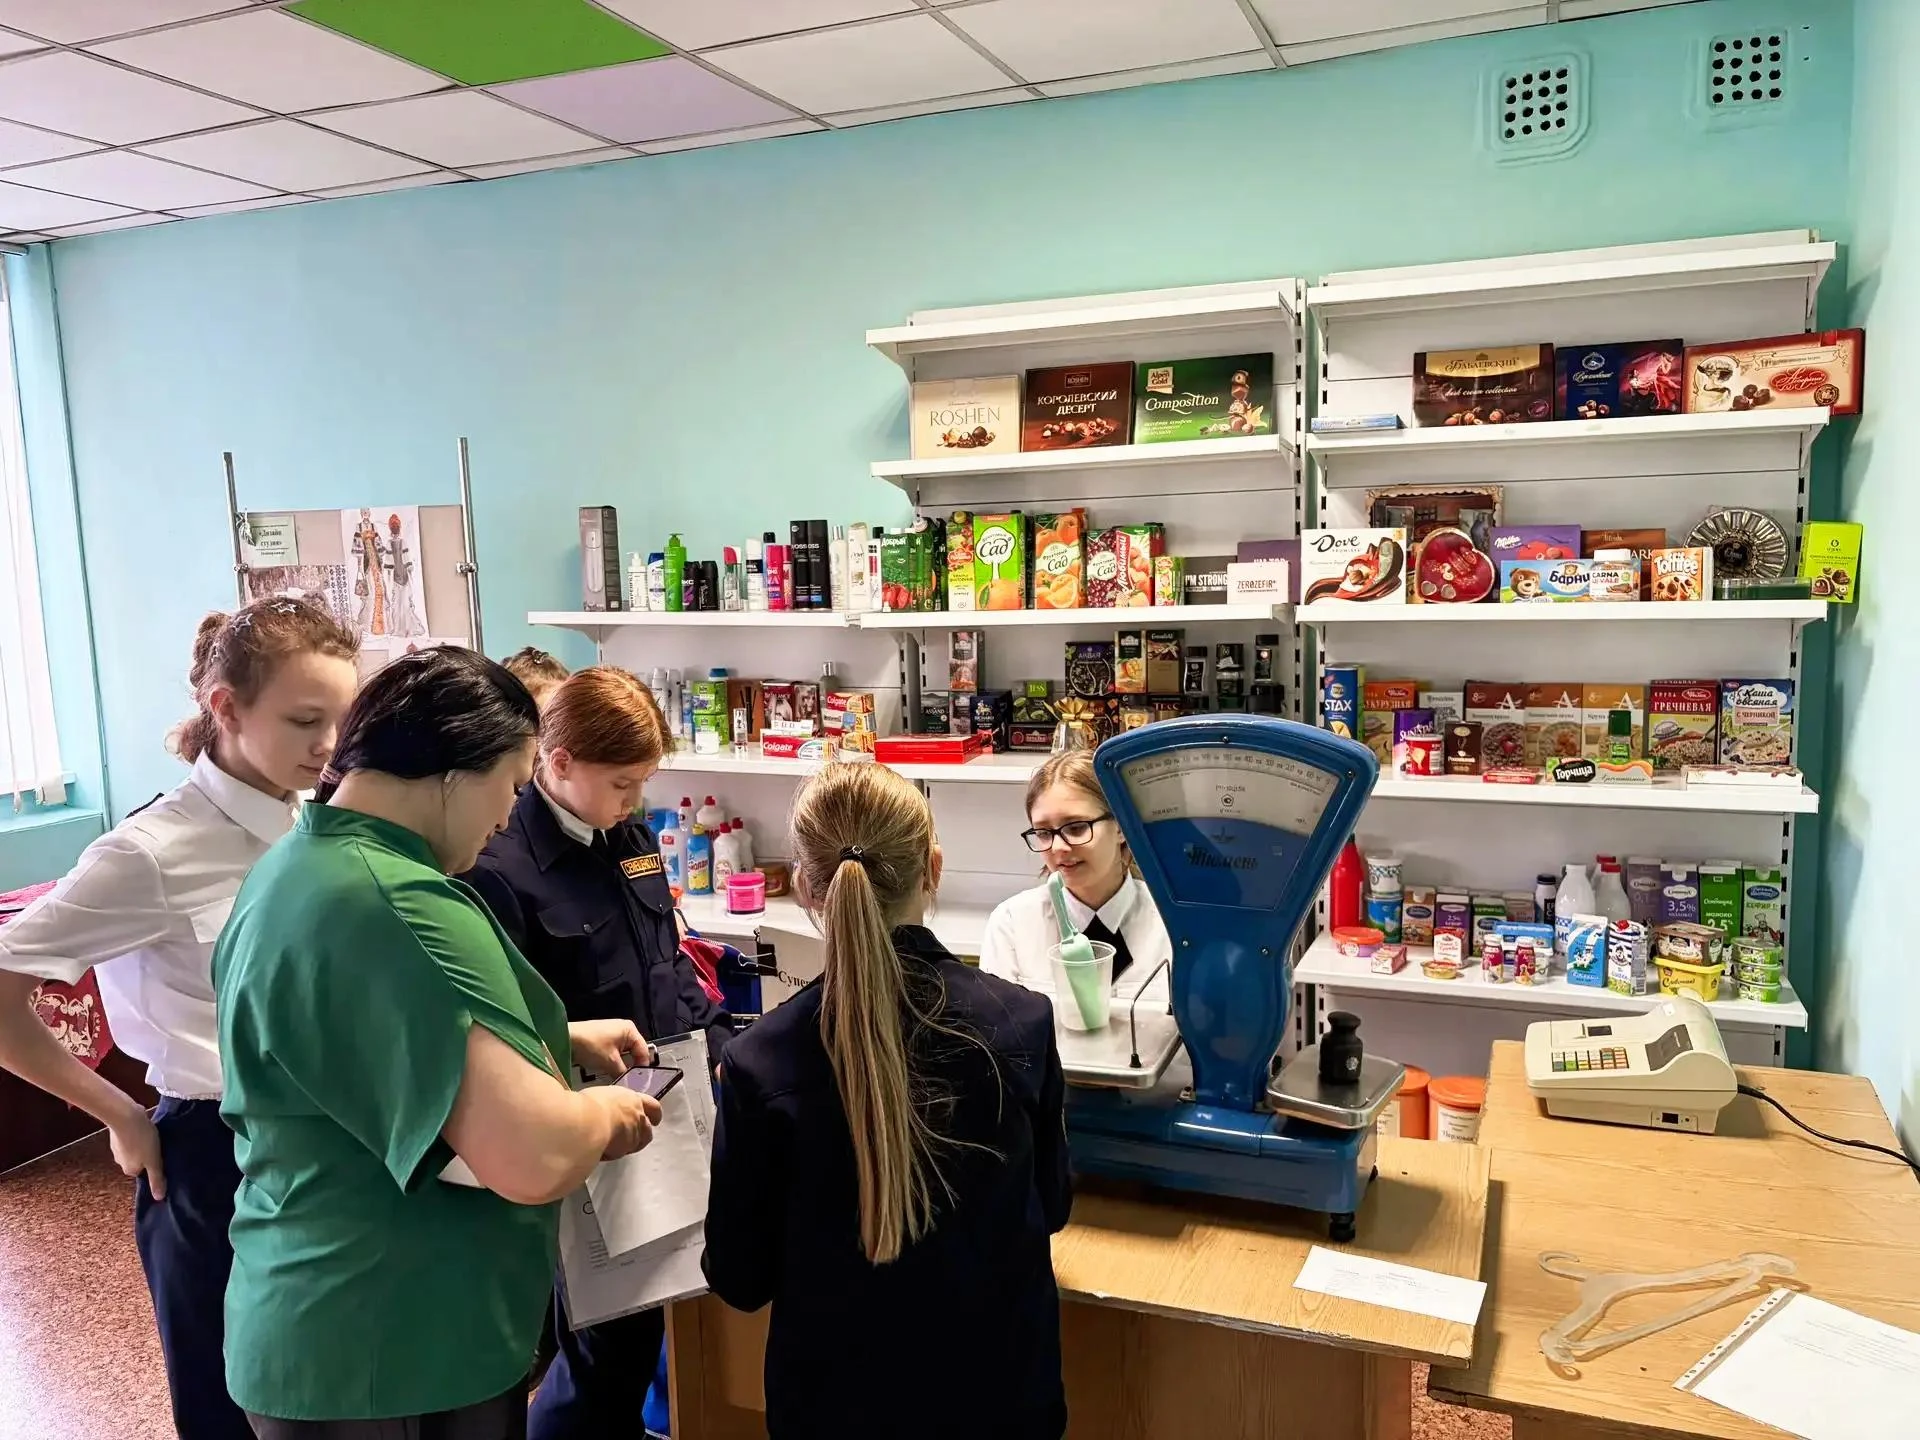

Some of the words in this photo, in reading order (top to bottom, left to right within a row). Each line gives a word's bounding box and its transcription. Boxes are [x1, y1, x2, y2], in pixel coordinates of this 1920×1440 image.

[1151, 370, 1170, 380] Alpen
[1152, 377, 1168, 386] Gold
[1037, 388, 1118, 406] КОРОЛЕВСКИЙ
[1145, 391, 1219, 415] Composition
[1056, 403, 1097, 416] ДЕСЕРТ
[930, 406, 1001, 427] ROSHEN
[979, 538, 1009, 558] Сад
[1310, 534, 1361, 553] Dove
[1494, 535, 1521, 548] Milka
[1047, 555, 1069, 572] Сад
[1096, 562, 1116, 577] Сад
[1549, 570, 1590, 586] Барни
[1742, 687, 1773, 700] Каша
[827, 695, 847, 706] Colgate
[1324, 699, 1352, 711] STAX
[1654, 701, 1712, 712] ГРЕЧНЕВАЯ
[1736, 696, 1778, 706] овсяная
[763, 741, 794, 753] Colgate
[1555, 765, 1593, 780] Горчица
